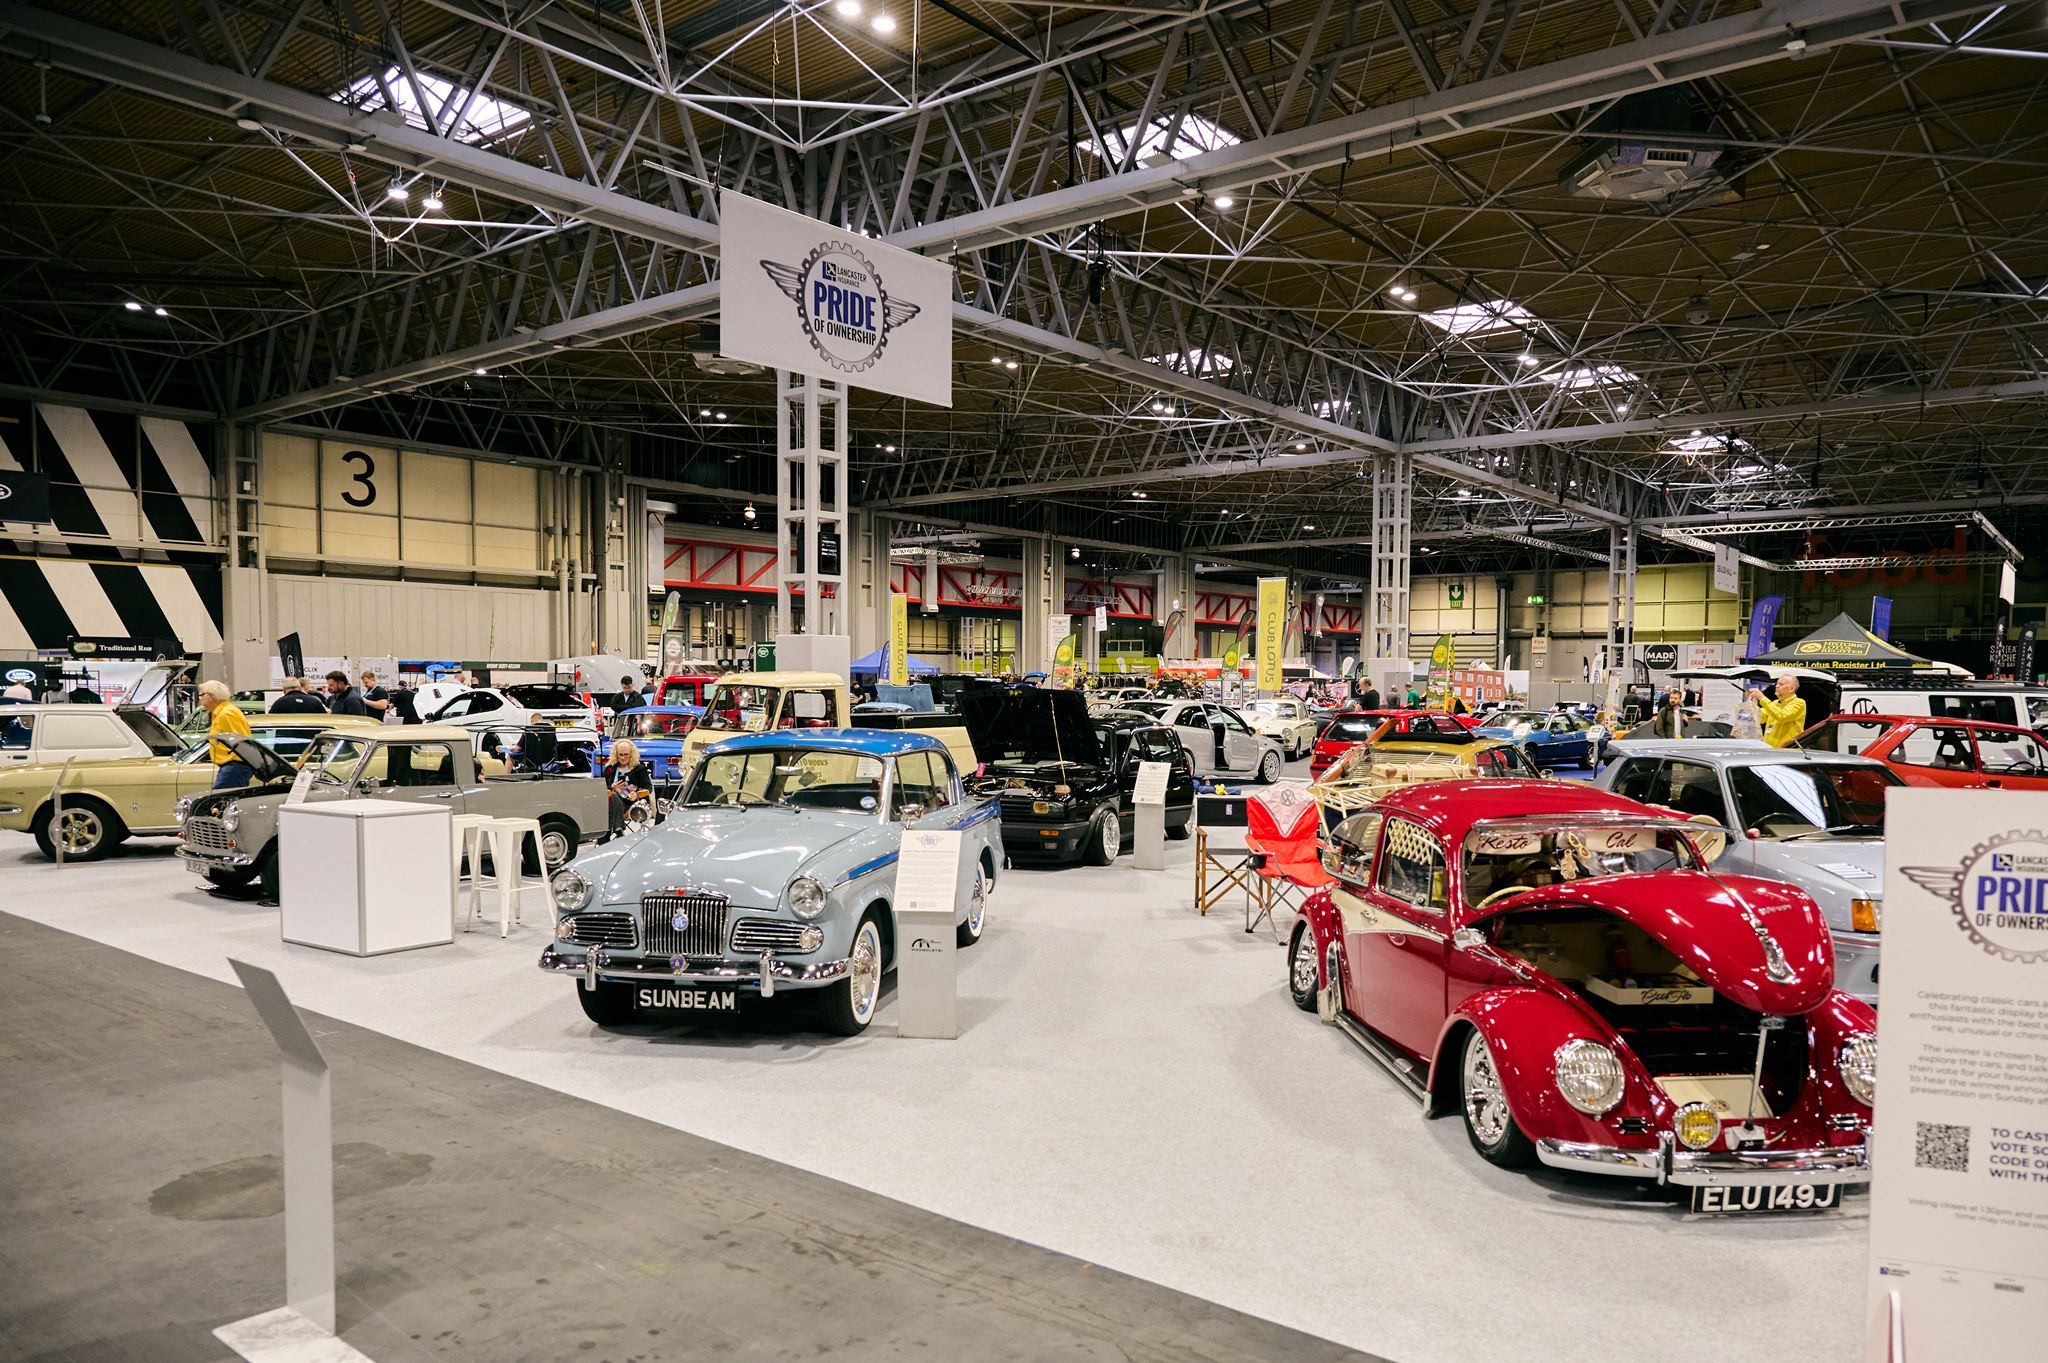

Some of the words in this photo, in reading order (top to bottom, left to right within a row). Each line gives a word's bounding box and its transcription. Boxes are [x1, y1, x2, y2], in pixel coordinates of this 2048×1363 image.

[837, 265, 867, 283] LANCASTER
[837, 275, 861, 289] INSURANCE
[814, 280, 877, 332] PRIDE
[814, 319, 826, 333] OF
[827, 322, 877, 346] OWNERSHIP
[341, 450, 377, 507] 3
[1266, 611, 1277, 643] CLUB
[1265, 645, 1276, 683] LOTUS
[1647, 652, 1675, 660] MADE
[1478, 835, 1530, 850] Resto
[1606, 831, 1638, 849] Cal
[1976, 913, 1994, 928] OF
[639, 989, 735, 1010] SUNBEAM
[1917, 990, 1978, 1004] Celebrating
[1980, 996, 2014, 1006] classic
[2017, 1000, 2040, 1008] cars
[1929, 1002, 1948, 1011] this
[1950, 1003, 1996, 1015] fantastic
[1998, 1008, 2035, 1019] display
[1909, 1012, 1969, 1023] enthusiasts
[1971, 1017, 1995, 1025] with
[1997, 1018, 2015, 1027] the
[2017, 1020, 2041, 1029] best
[1957, 1027, 2000, 1037] unusual
[1921, 1043, 1941, 1052] The
[1944, 1046, 1980, 1056] winner
[1983, 1049, 1992, 1057] is
[1993, 1050, 2032, 1060] chosen
[1918, 1055, 1957, 1065] explore
[1959, 1058, 1977, 1067] the
[2005, 1063, 2026, 1071] and
[1909, 1064, 1934, 1073] then
[1936, 1067, 1959, 1076] vote
[1961, 1068, 1975, 1077] for
[1977, 1071, 2001, 1080] your
[1909, 1074, 1920, 1082] to
[1923, 1075, 1946, 1084] hear
[1949, 1078, 1967, 1087] the
[1969, 1081, 2011, 1091] winners
[1910, 1086, 1976, 1098] presentation
[1994, 1093, 2035, 1105] Sunday
[1990, 1127, 2010, 1138] TO
[2014, 1130, 2048, 1142] CAST
[1990, 1141, 2028, 1154] VOTE
[1989, 1155, 2029, 1167] CODE
[1989, 1168, 2028, 1180] WITH
[1702, 1185, 1762, 1212] ELU
[1767, 1183, 1836, 1210] 149J
[1908, 1198, 1938, 1208] Voting
